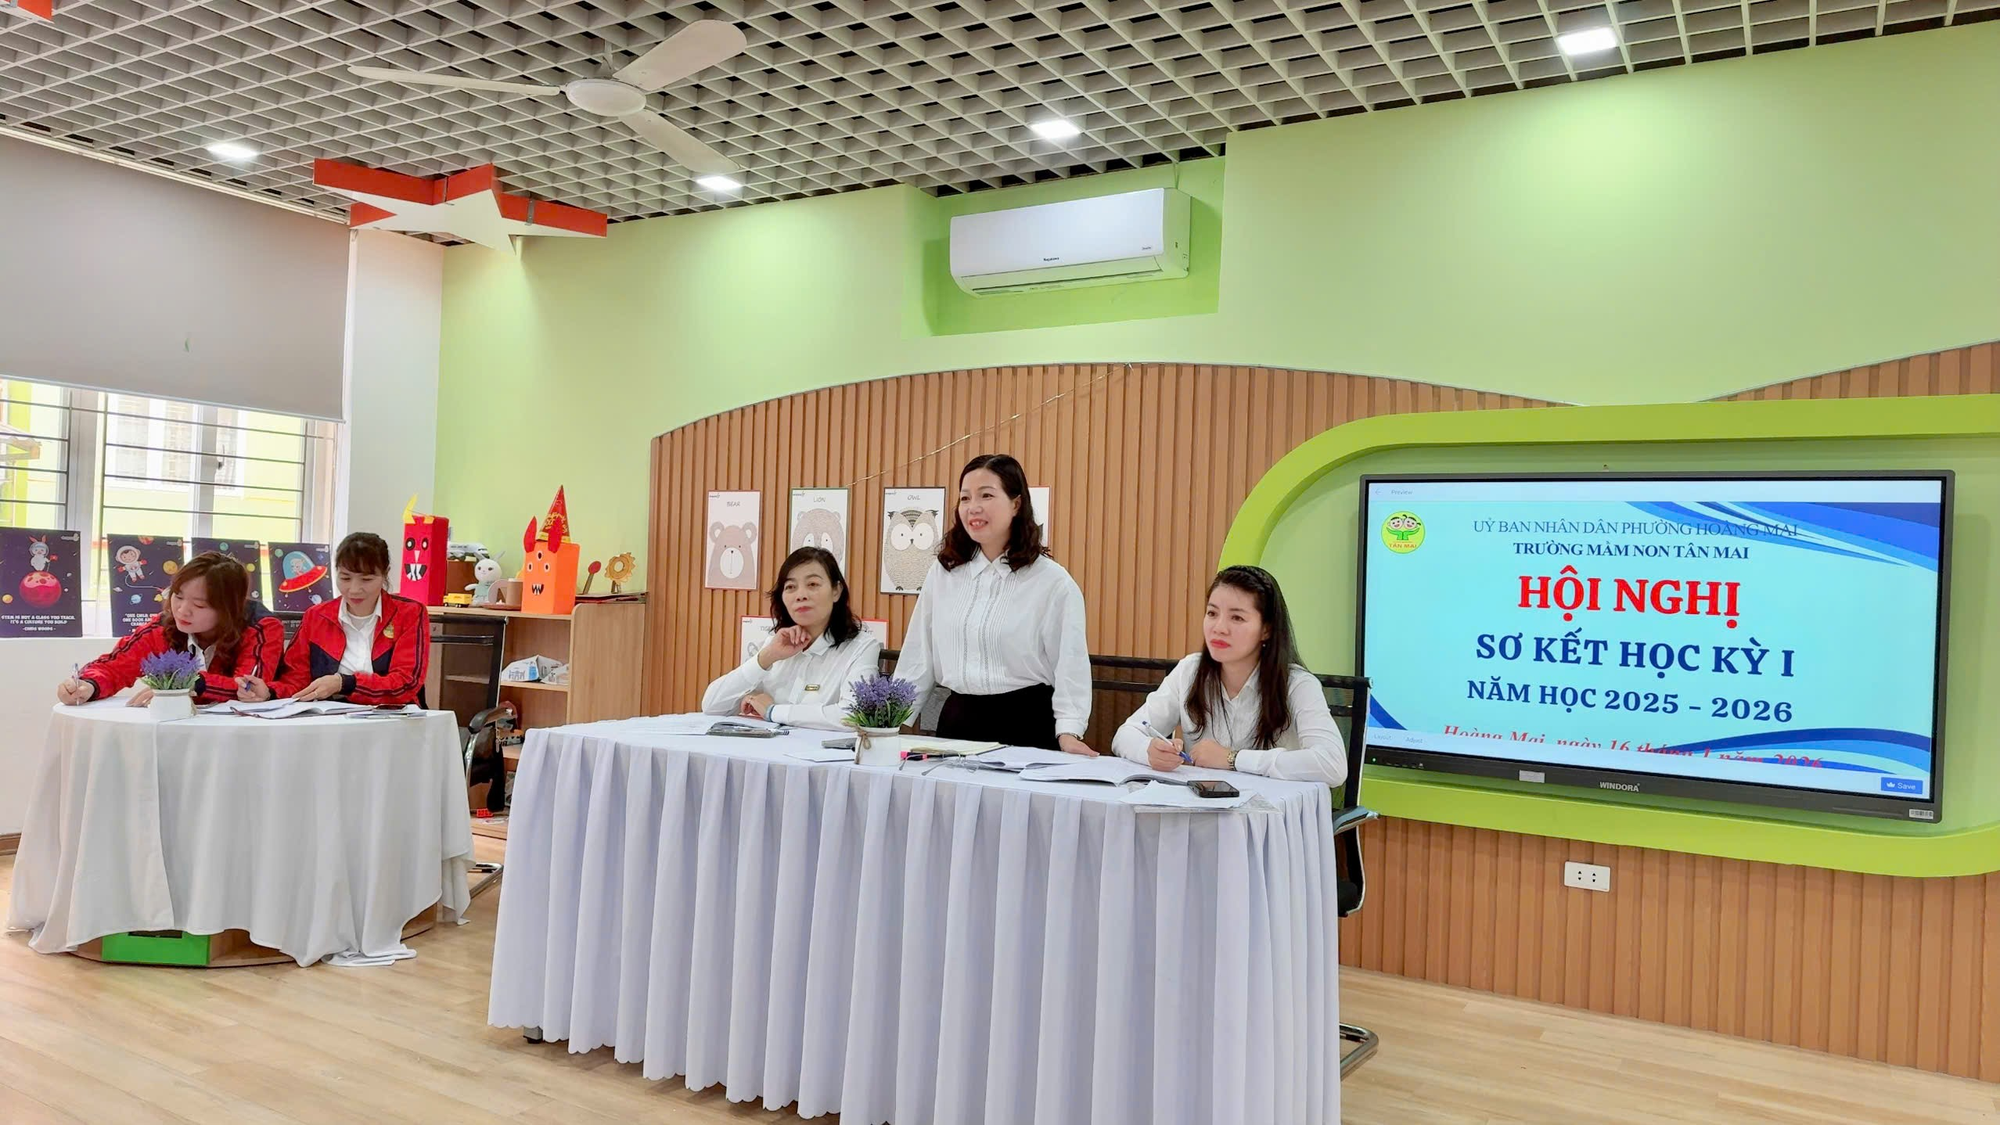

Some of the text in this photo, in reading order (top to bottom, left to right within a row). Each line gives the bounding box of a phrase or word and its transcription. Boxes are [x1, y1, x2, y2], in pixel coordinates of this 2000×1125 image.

[1473, 517, 1798, 537] UỶ BAN NHÂN DÂN PHƯỜNG HOÀNG MAI
[1512, 540, 1583, 556] TRƯỜNG
[1632, 544, 1670, 558] NON
[1673, 542, 1709, 559] TÂN
[1713, 546, 1750, 559] MAI
[1518, 564, 1741, 629] HỘI NGHỊ
[1476, 627, 1795, 679] SƠ KẾT HỌC KỲ I
[1467, 675, 1531, 703] NĂM
[1539, 684, 1597, 713] HỌC
[1604, 690, 1679, 714] 2025
[1711, 697, 1793, 723] 2026
[1599, 781, 1640, 792] WINDORA
[1897, 782, 1916, 791] Save
